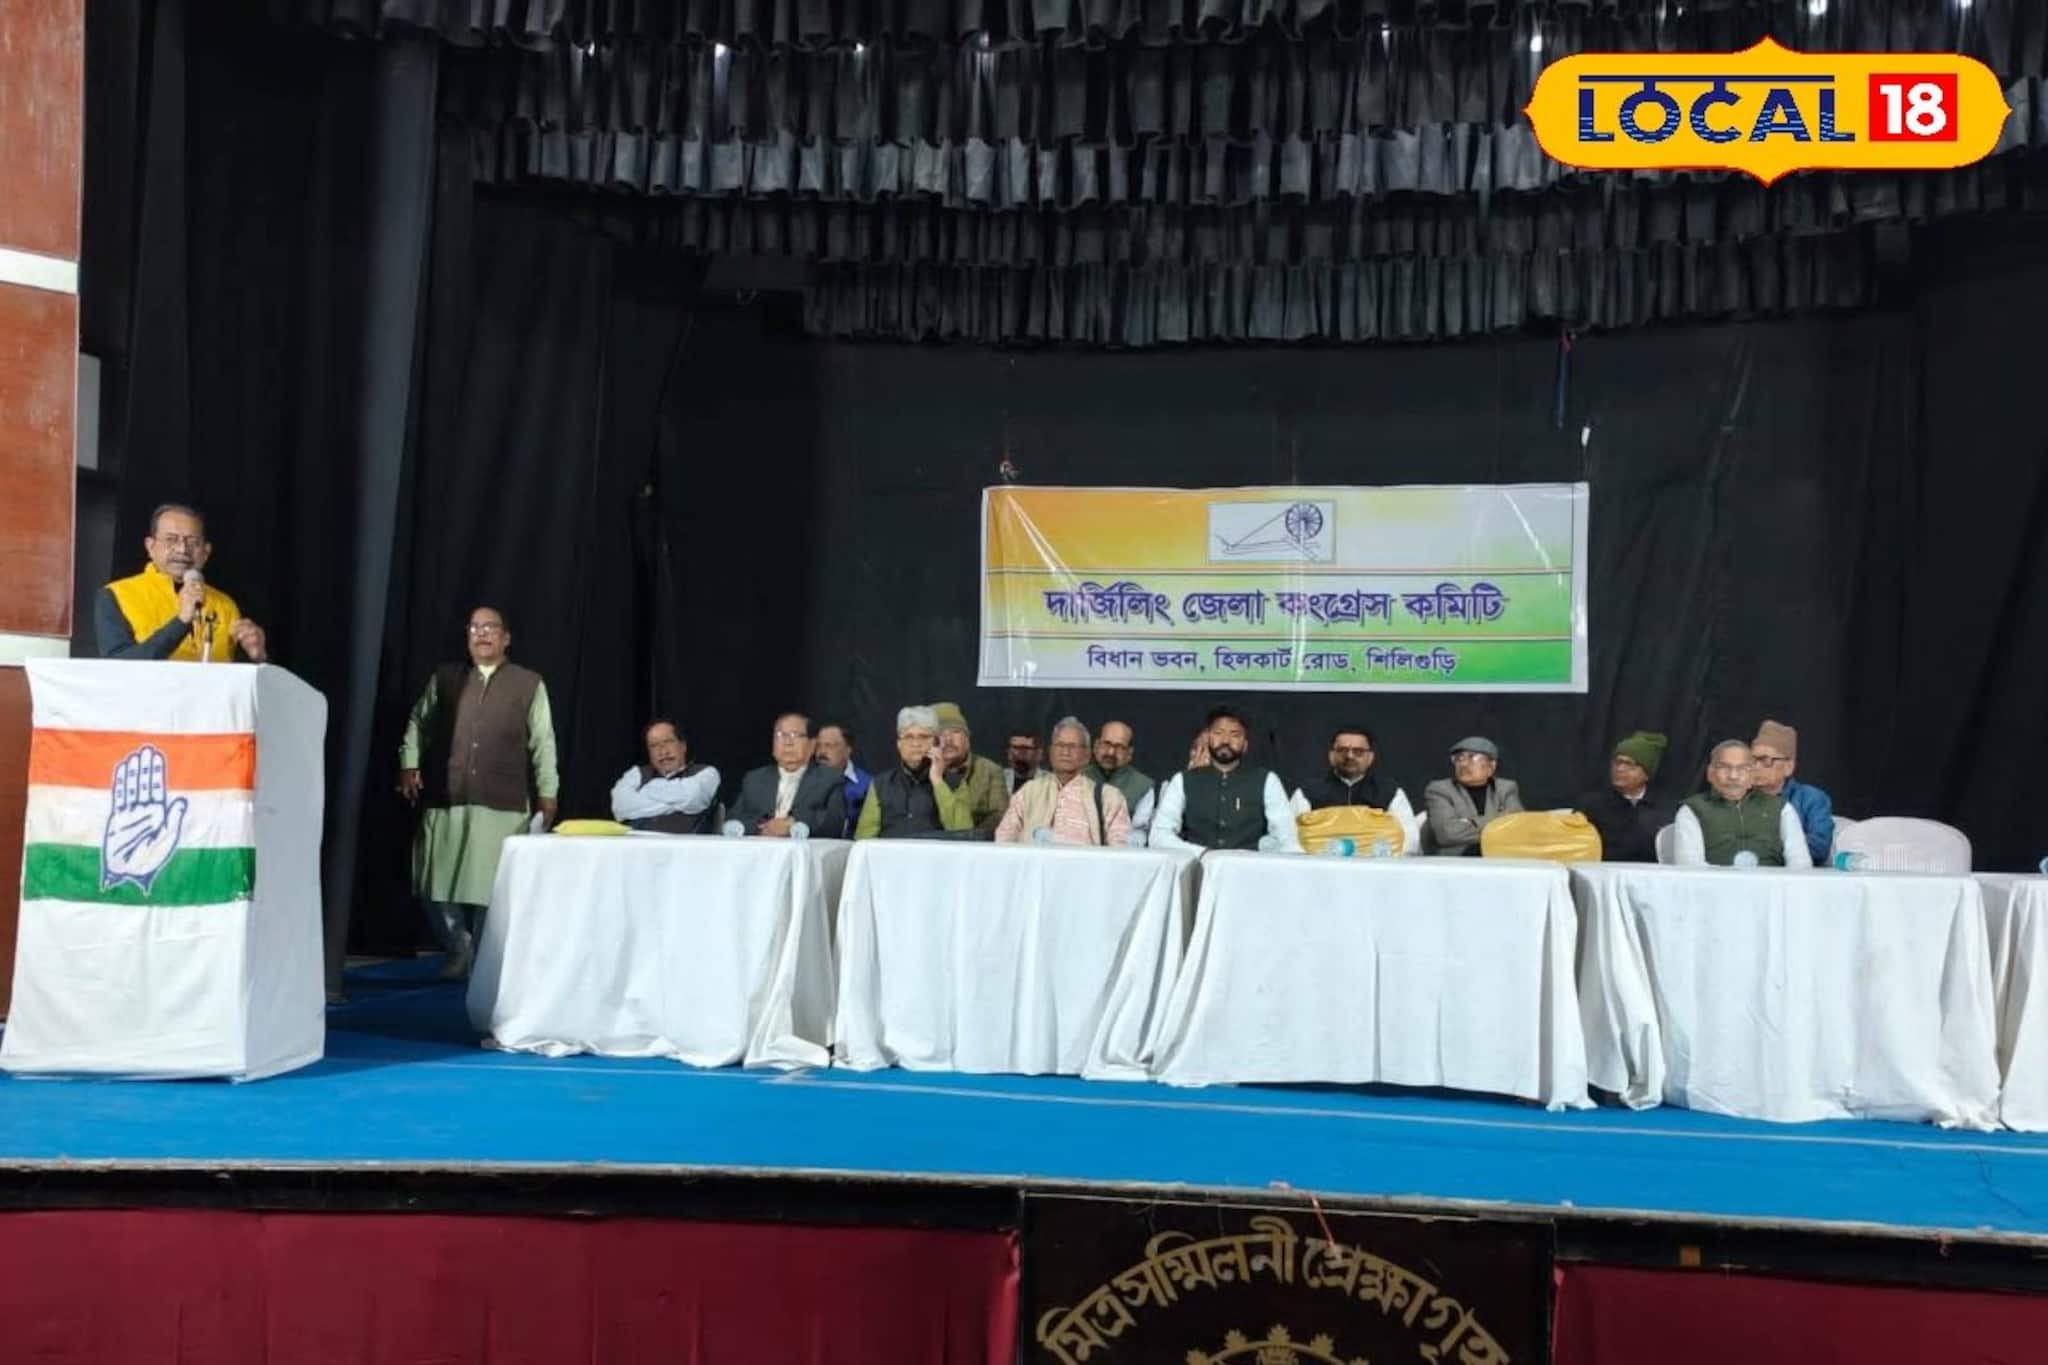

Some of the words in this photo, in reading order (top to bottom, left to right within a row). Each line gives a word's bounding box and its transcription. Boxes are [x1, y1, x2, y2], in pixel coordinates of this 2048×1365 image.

[1043, 581, 1175, 626] দার্জিলিং
[1182, 588, 1270, 625] জেলা
[1275, 588, 1396, 627] কংগ্রেস
[1401, 582, 1508, 625] কমিটি
[1087, 644, 1143, 669] বিধান
[1151, 650, 1206, 672] ভবন,
[1214, 646, 1293, 671] হিলকার্ট
[1302, 651, 1356, 672] রোড,
[1366, 647, 1457, 676] শিলিগুড়ি
[1036, 1216, 1298, 1365] মিত্রসম্মিলনী
